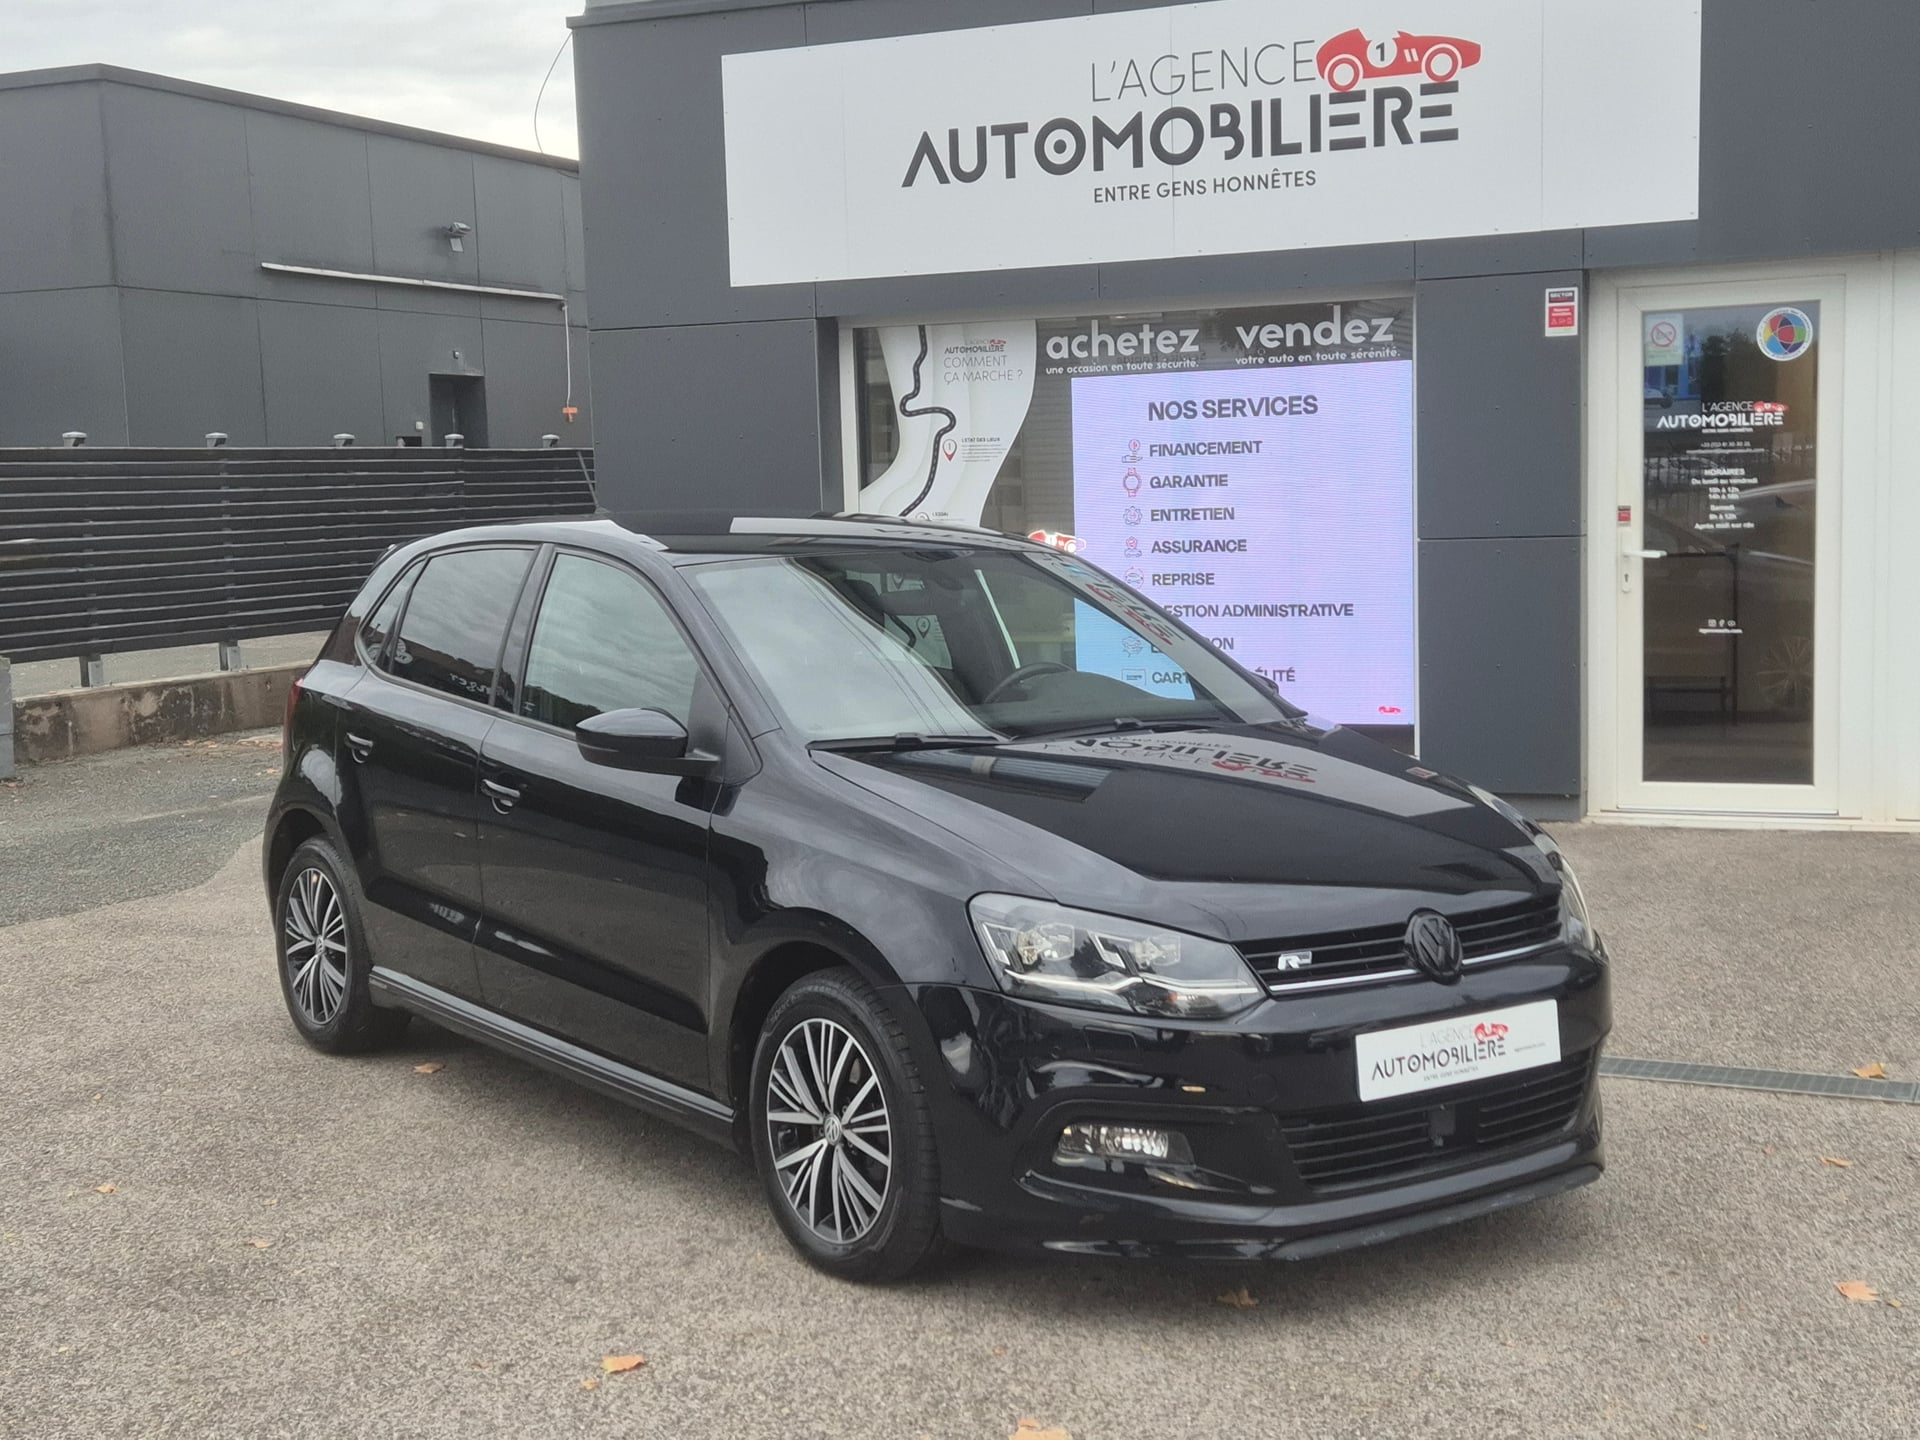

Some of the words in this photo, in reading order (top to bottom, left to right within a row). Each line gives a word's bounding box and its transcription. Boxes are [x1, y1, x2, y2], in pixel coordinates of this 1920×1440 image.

[1092, 40, 1316, 102] L'AGENCE
[901, 80, 1459, 188] AUTOMOBILIERE
[1094, 184, 1151, 203] ENTRE
[1156, 178, 1208, 198] GENS
[1212, 168, 1316, 194] HONNÊTES
[1235, 304, 1395, 350] vendez
[1046, 319, 1200, 360] achetez
[943, 354, 1007, 369] COMMENT
[1235, 354, 1265, 365] votre
[1268, 353, 1295, 364] auto
[1298, 354, 1312, 362] en
[1315, 351, 1347, 361] toute
[1046, 366, 1064, 375] une
[1066, 363, 1108, 374] occasion
[1111, 364, 1124, 372] en
[1126, 361, 1154, 371] toute
[943, 371, 960, 386] ÇA
[962, 369, 1014, 382] MARCHE
[1149, 400, 1199, 422] NOS
[1202, 394, 1319, 419] SERVICES
[1149, 440, 1263, 457] FINANCEMENT
[1150, 473, 1229, 489] GARANTIE
[1150, 507, 1235, 522] ENTRETIEN
[1151, 538, 1248, 554] ASSURANCE
[1152, 572, 1216, 586] REPRISE
[1160, 603, 1219, 618] ESTION
[1221, 603, 1354, 618] ADMINISTRATIVE
[1152, 671, 1190, 684] CART
[1371, 1036, 1506, 1081] AUTOMOBILIERE
